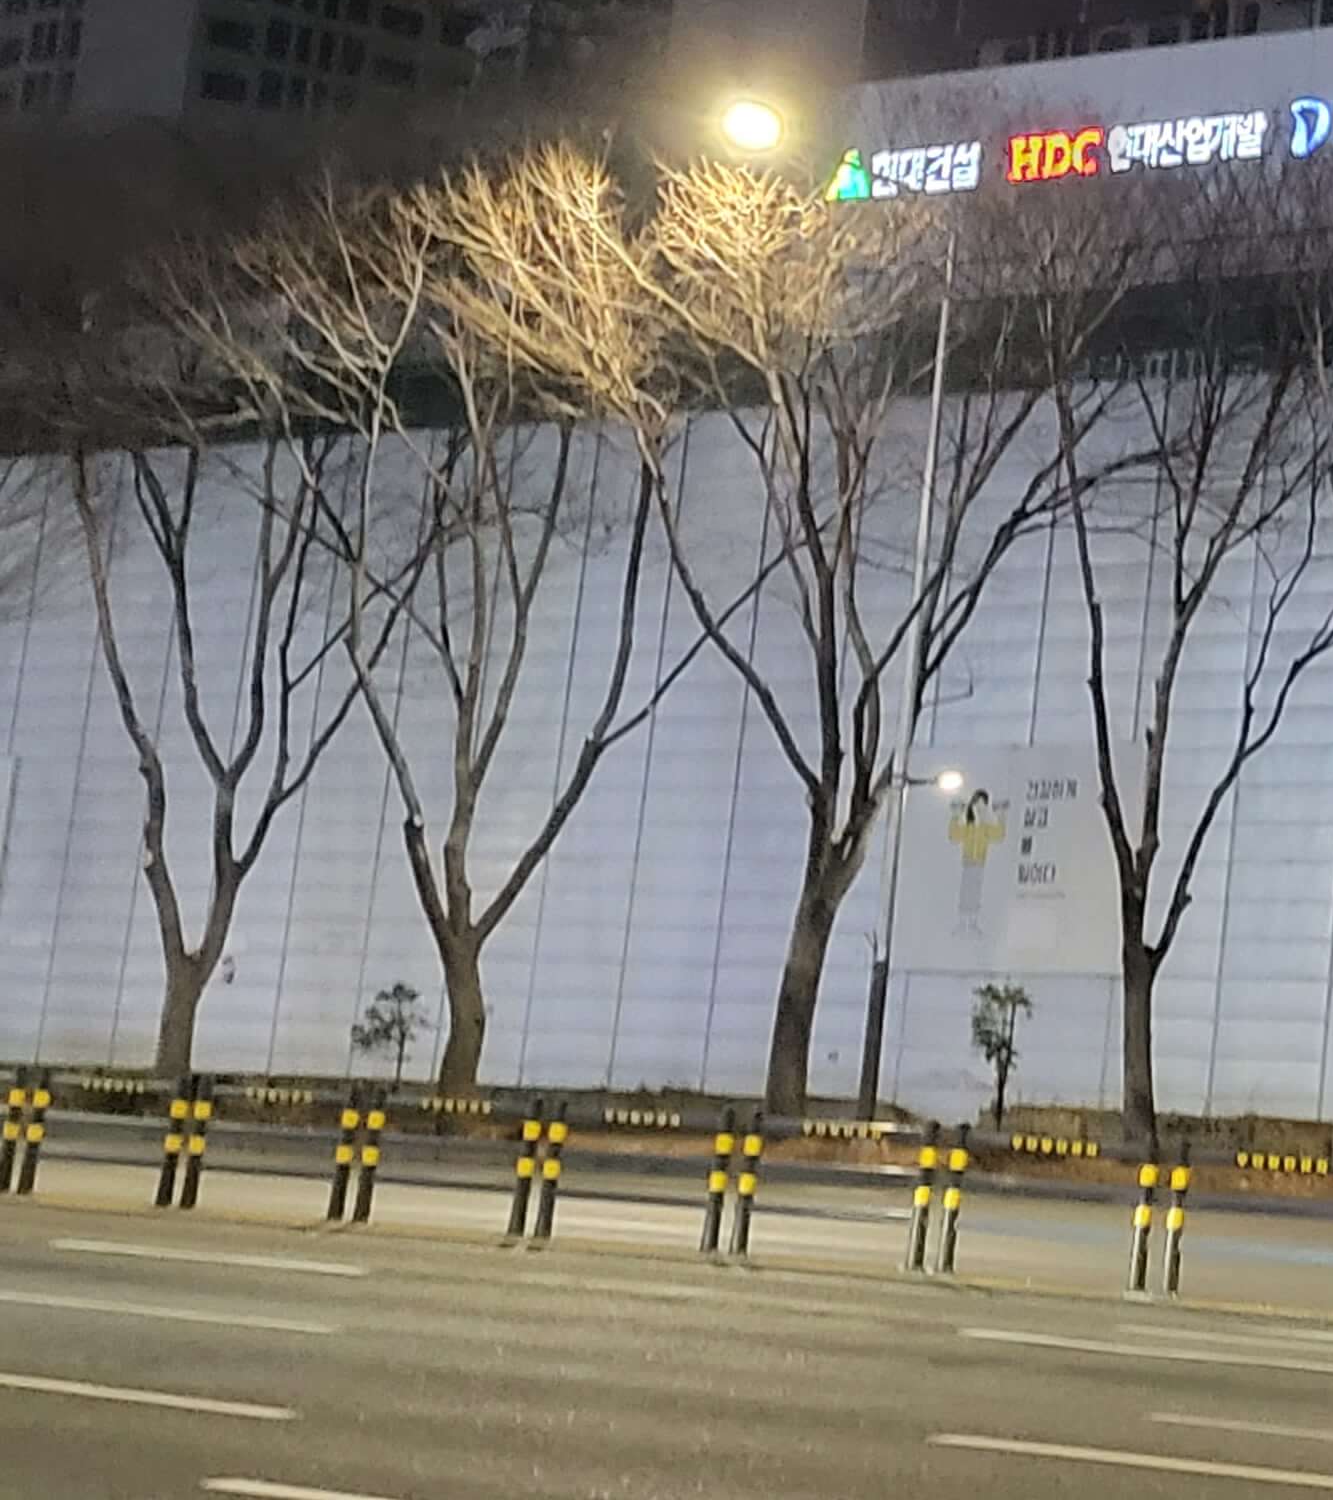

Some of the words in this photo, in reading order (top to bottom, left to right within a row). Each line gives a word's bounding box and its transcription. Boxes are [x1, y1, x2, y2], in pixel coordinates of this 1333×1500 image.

[871, 143, 982, 199] 현대건설
[1007, 125, 1103, 182] HDC
[1107, 109, 1269, 173] 현대산업개발
